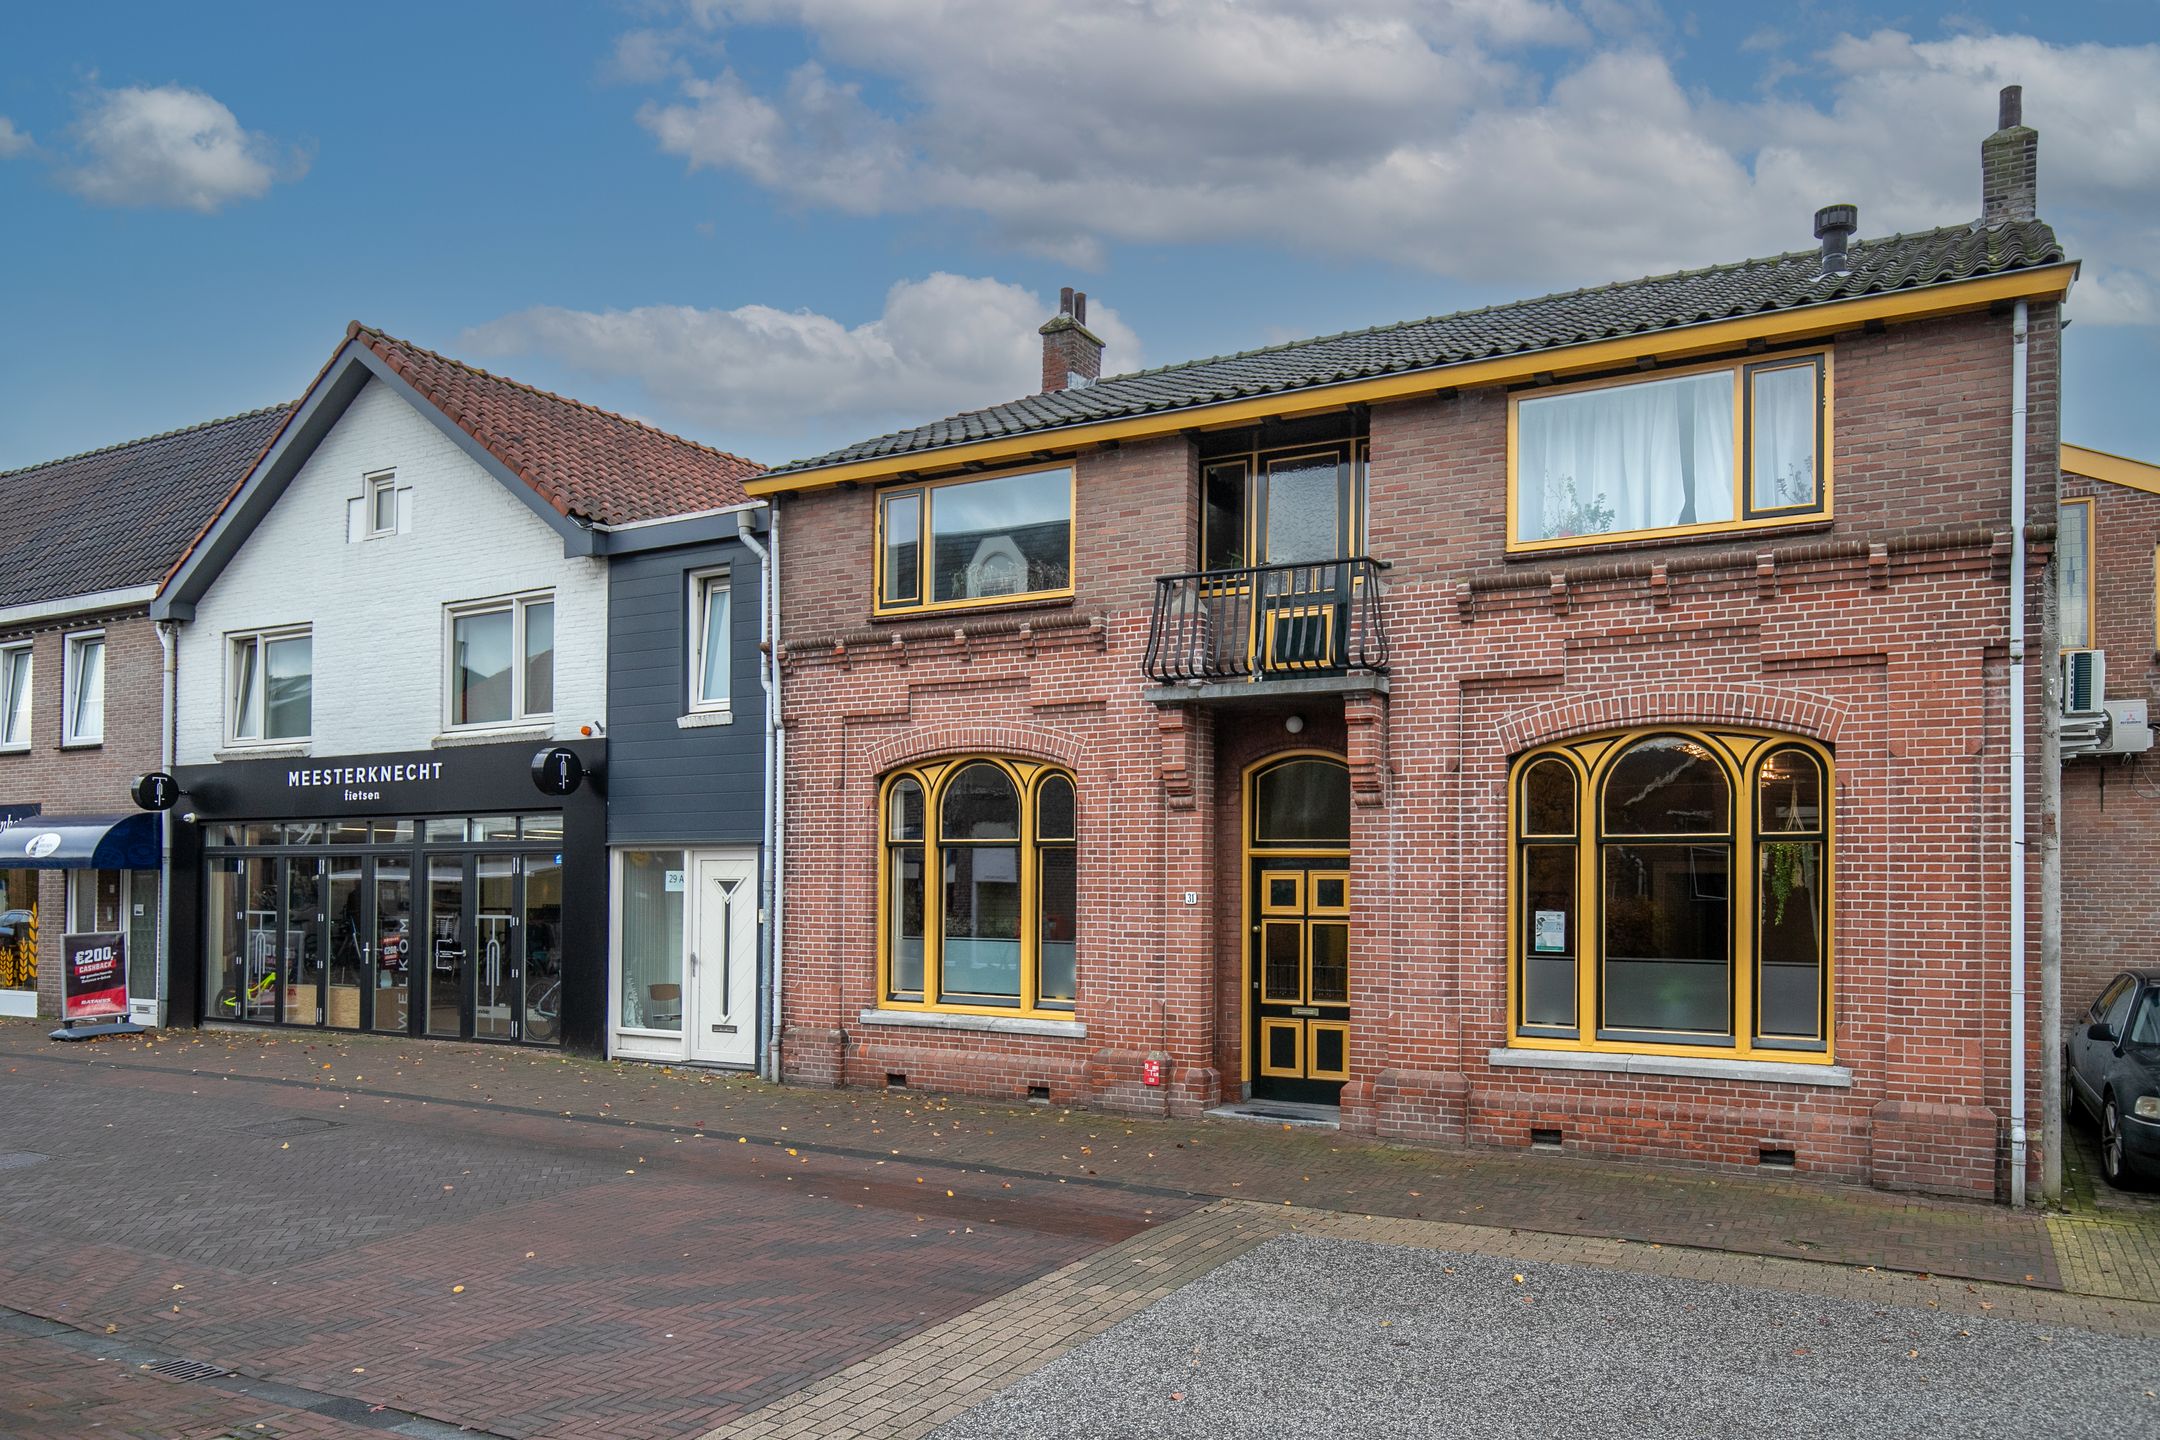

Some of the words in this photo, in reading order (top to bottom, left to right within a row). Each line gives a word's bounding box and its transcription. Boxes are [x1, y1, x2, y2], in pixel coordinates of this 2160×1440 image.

[288, 762, 443, 787] MEESTERKNECHT
[344, 789, 380, 801] fietsen
[669, 874, 677, 883] 29
[679, 874, 684, 883] A
[1187, 893, 1195, 903] 31
[79, 960, 113, 974] CASHBACK
[398, 918, 408, 1029] WELKOM
